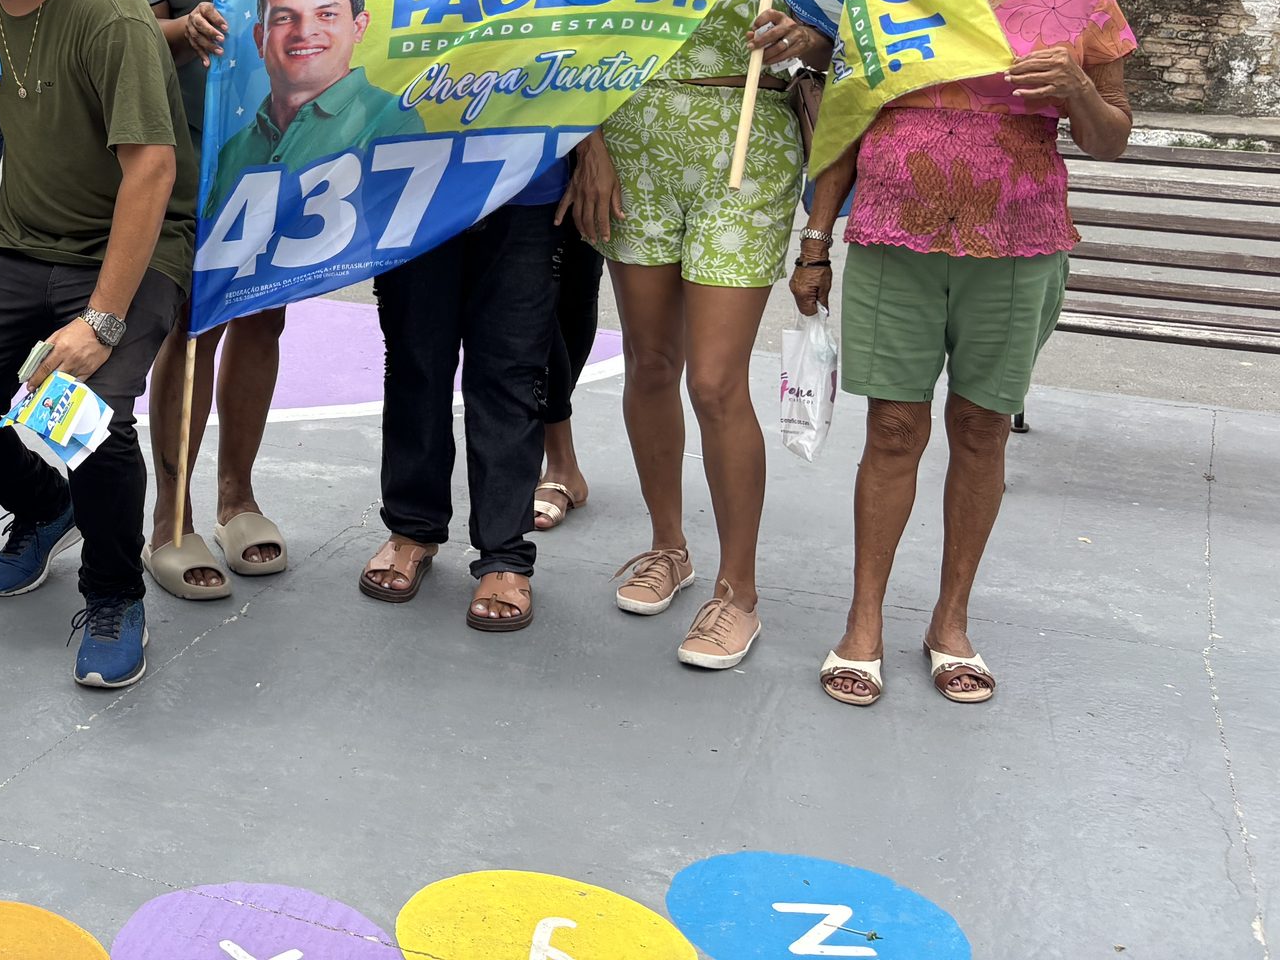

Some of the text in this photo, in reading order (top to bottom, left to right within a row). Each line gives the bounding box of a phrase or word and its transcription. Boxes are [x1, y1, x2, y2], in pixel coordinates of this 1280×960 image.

[402, 17, 688, 53] DEPUTADO ESTADUAL
[878, 11, 947, 73] Jr.
[399, 49, 659, 125] Chega Junto!
